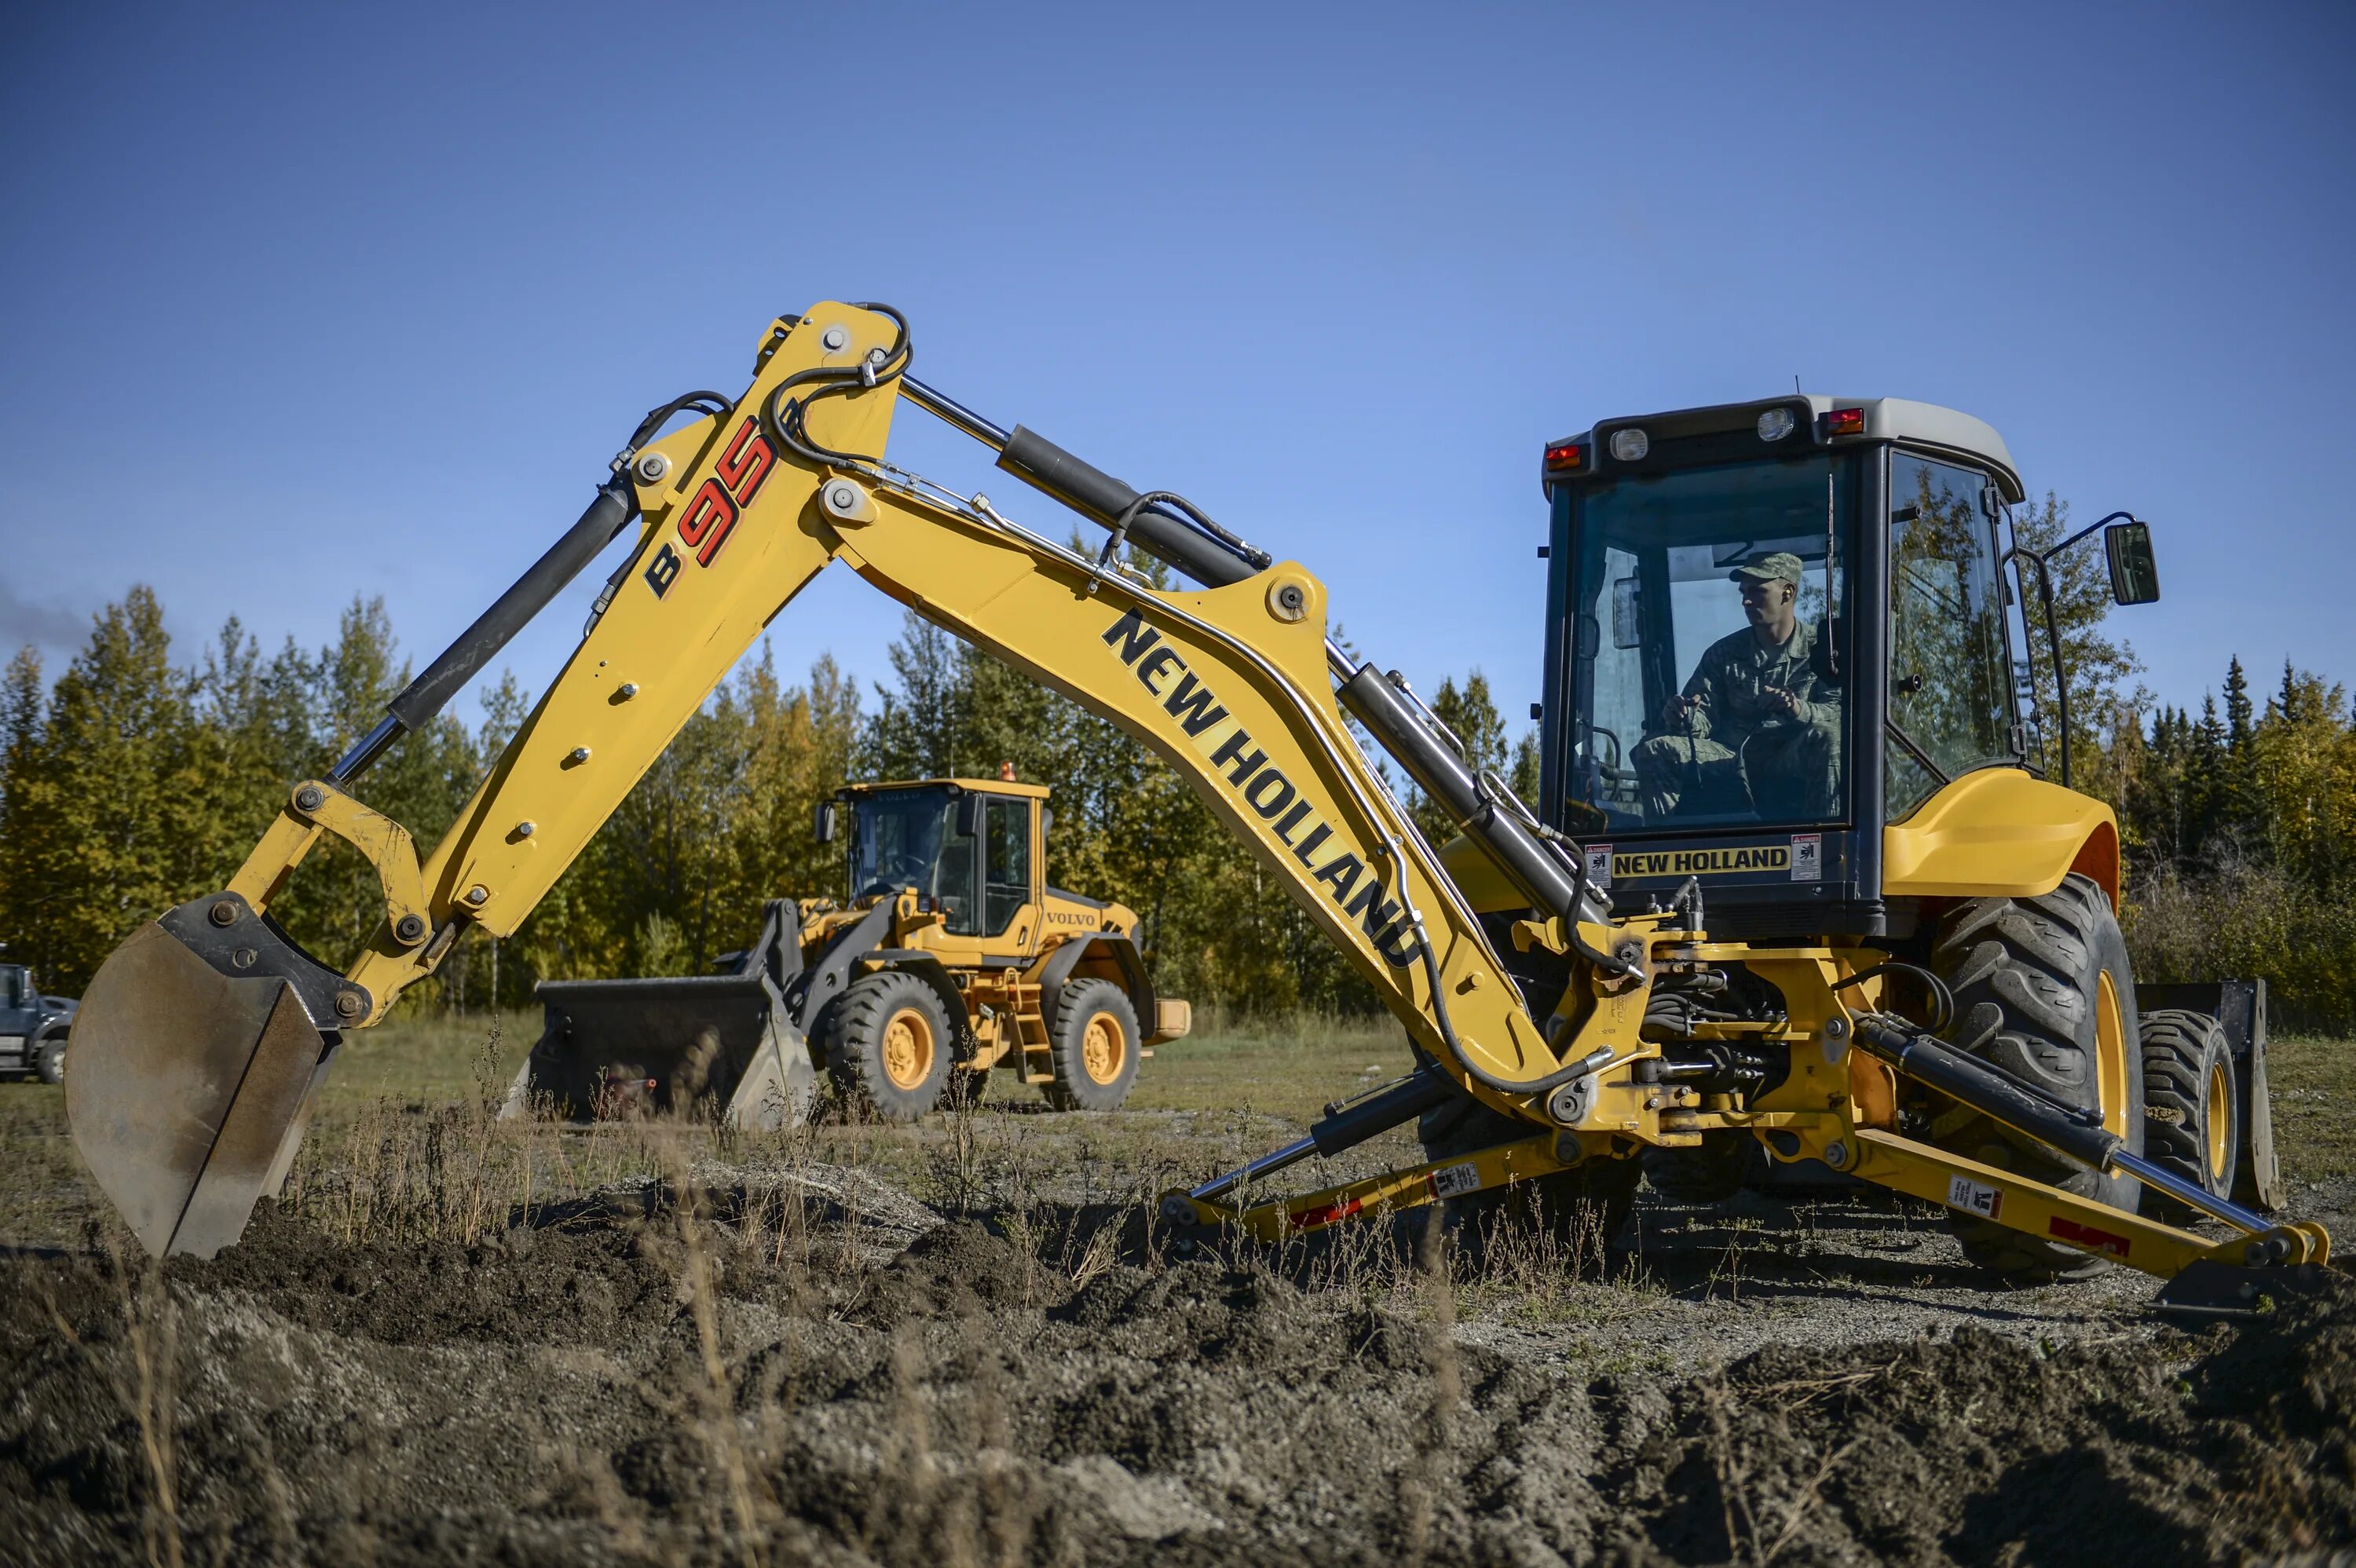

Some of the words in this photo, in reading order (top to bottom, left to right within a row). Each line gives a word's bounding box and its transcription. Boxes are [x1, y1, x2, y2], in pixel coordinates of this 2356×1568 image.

[1101, 606, 1229, 738] NEW
[1209, 729, 1422, 968] HOLLAND
[1615, 854, 1668, 874] NEW
[1674, 849, 1787, 872] HOLLAND
[1047, 912, 1095, 926] VOLVO
